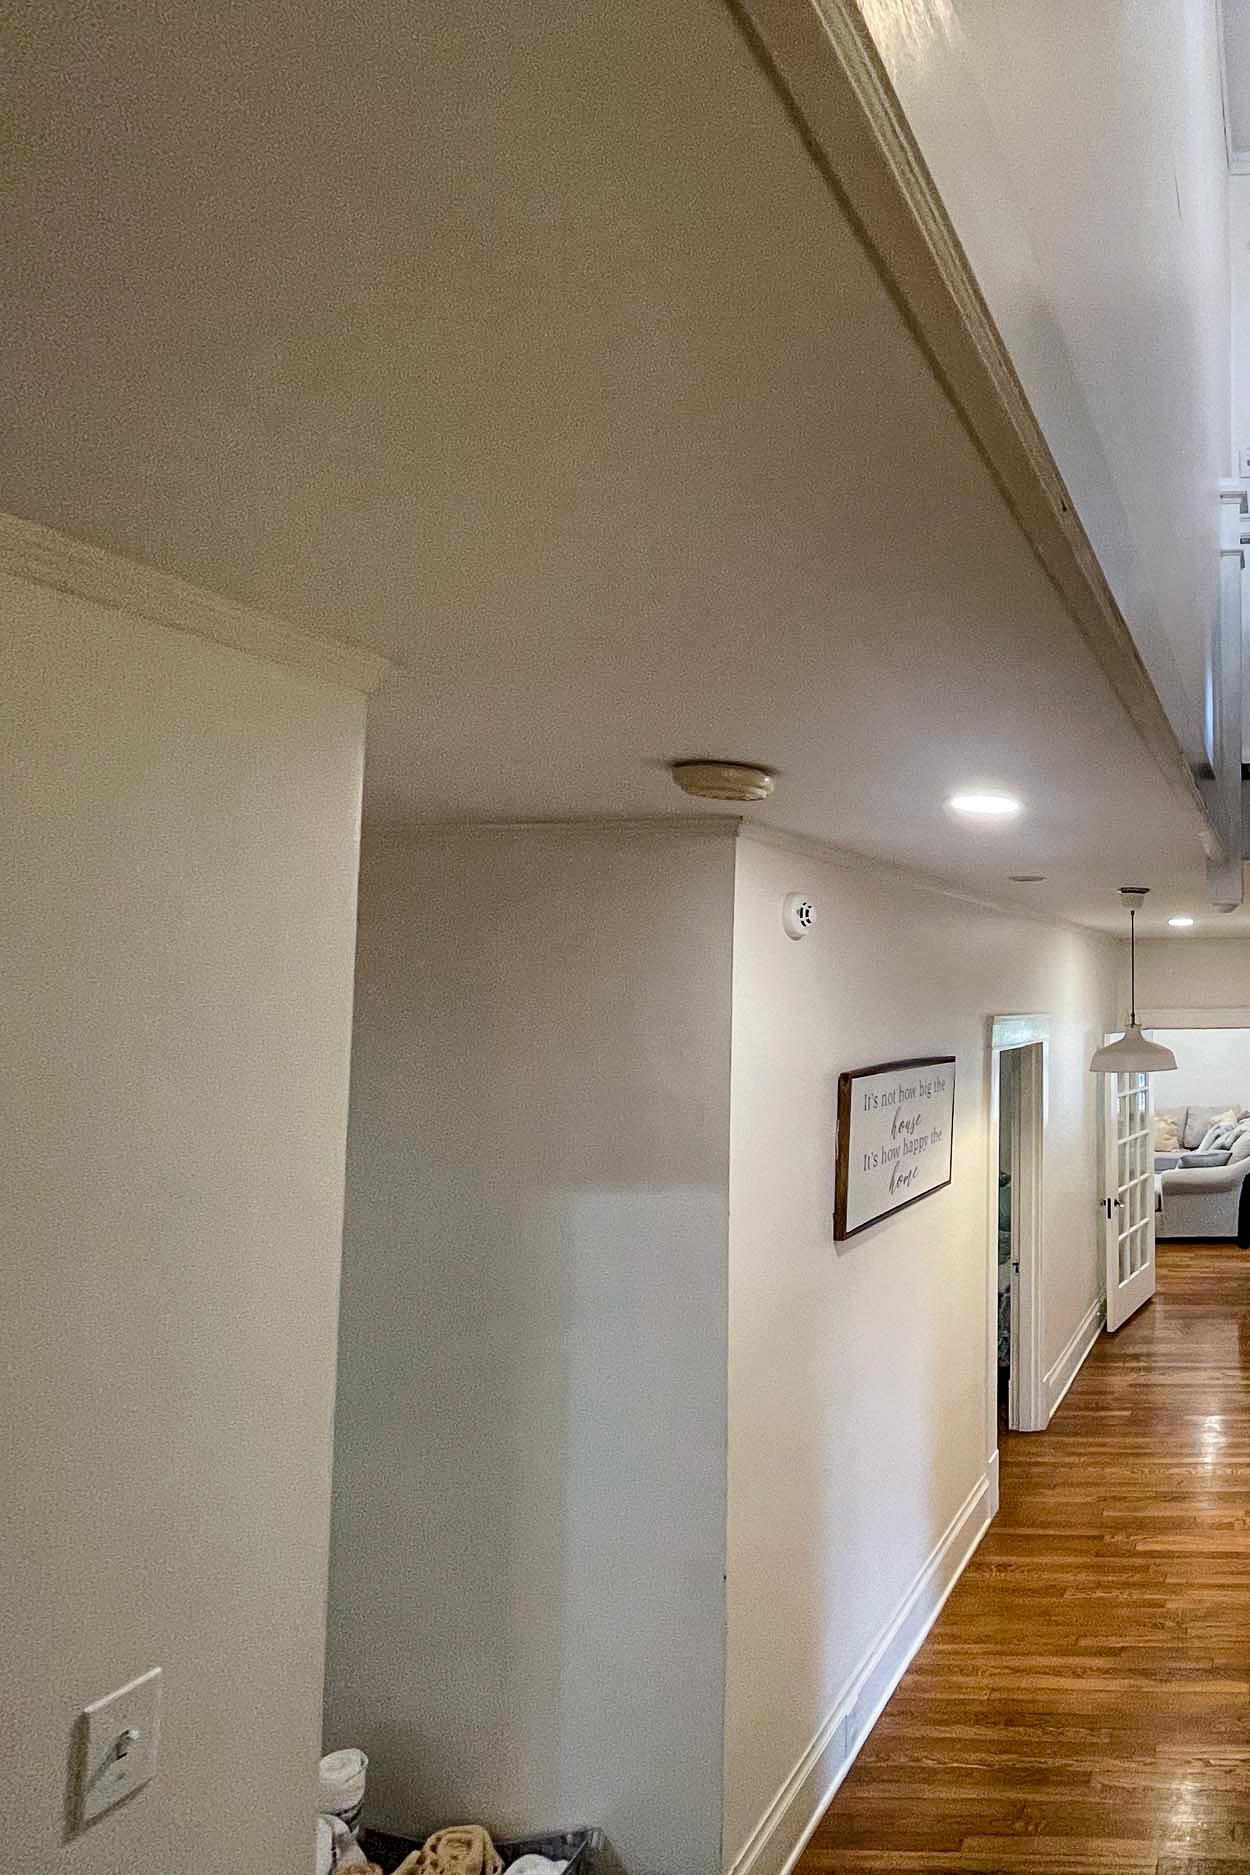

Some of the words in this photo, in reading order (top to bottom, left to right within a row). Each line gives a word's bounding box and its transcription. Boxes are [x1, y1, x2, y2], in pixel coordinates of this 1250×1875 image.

[864, 1091, 878, 1111] It's
[881, 1089, 896, 1107] not
[899, 1084, 916, 1102] how
[920, 1080, 931, 1099] big
[934, 1076, 945, 1092] the
[891, 1106, 921, 1140] house
[863, 1152, 878, 1171] It's
[881, 1145, 900, 1164] how
[903, 1136, 928, 1156] happy
[931, 1128, 942, 1143] the
